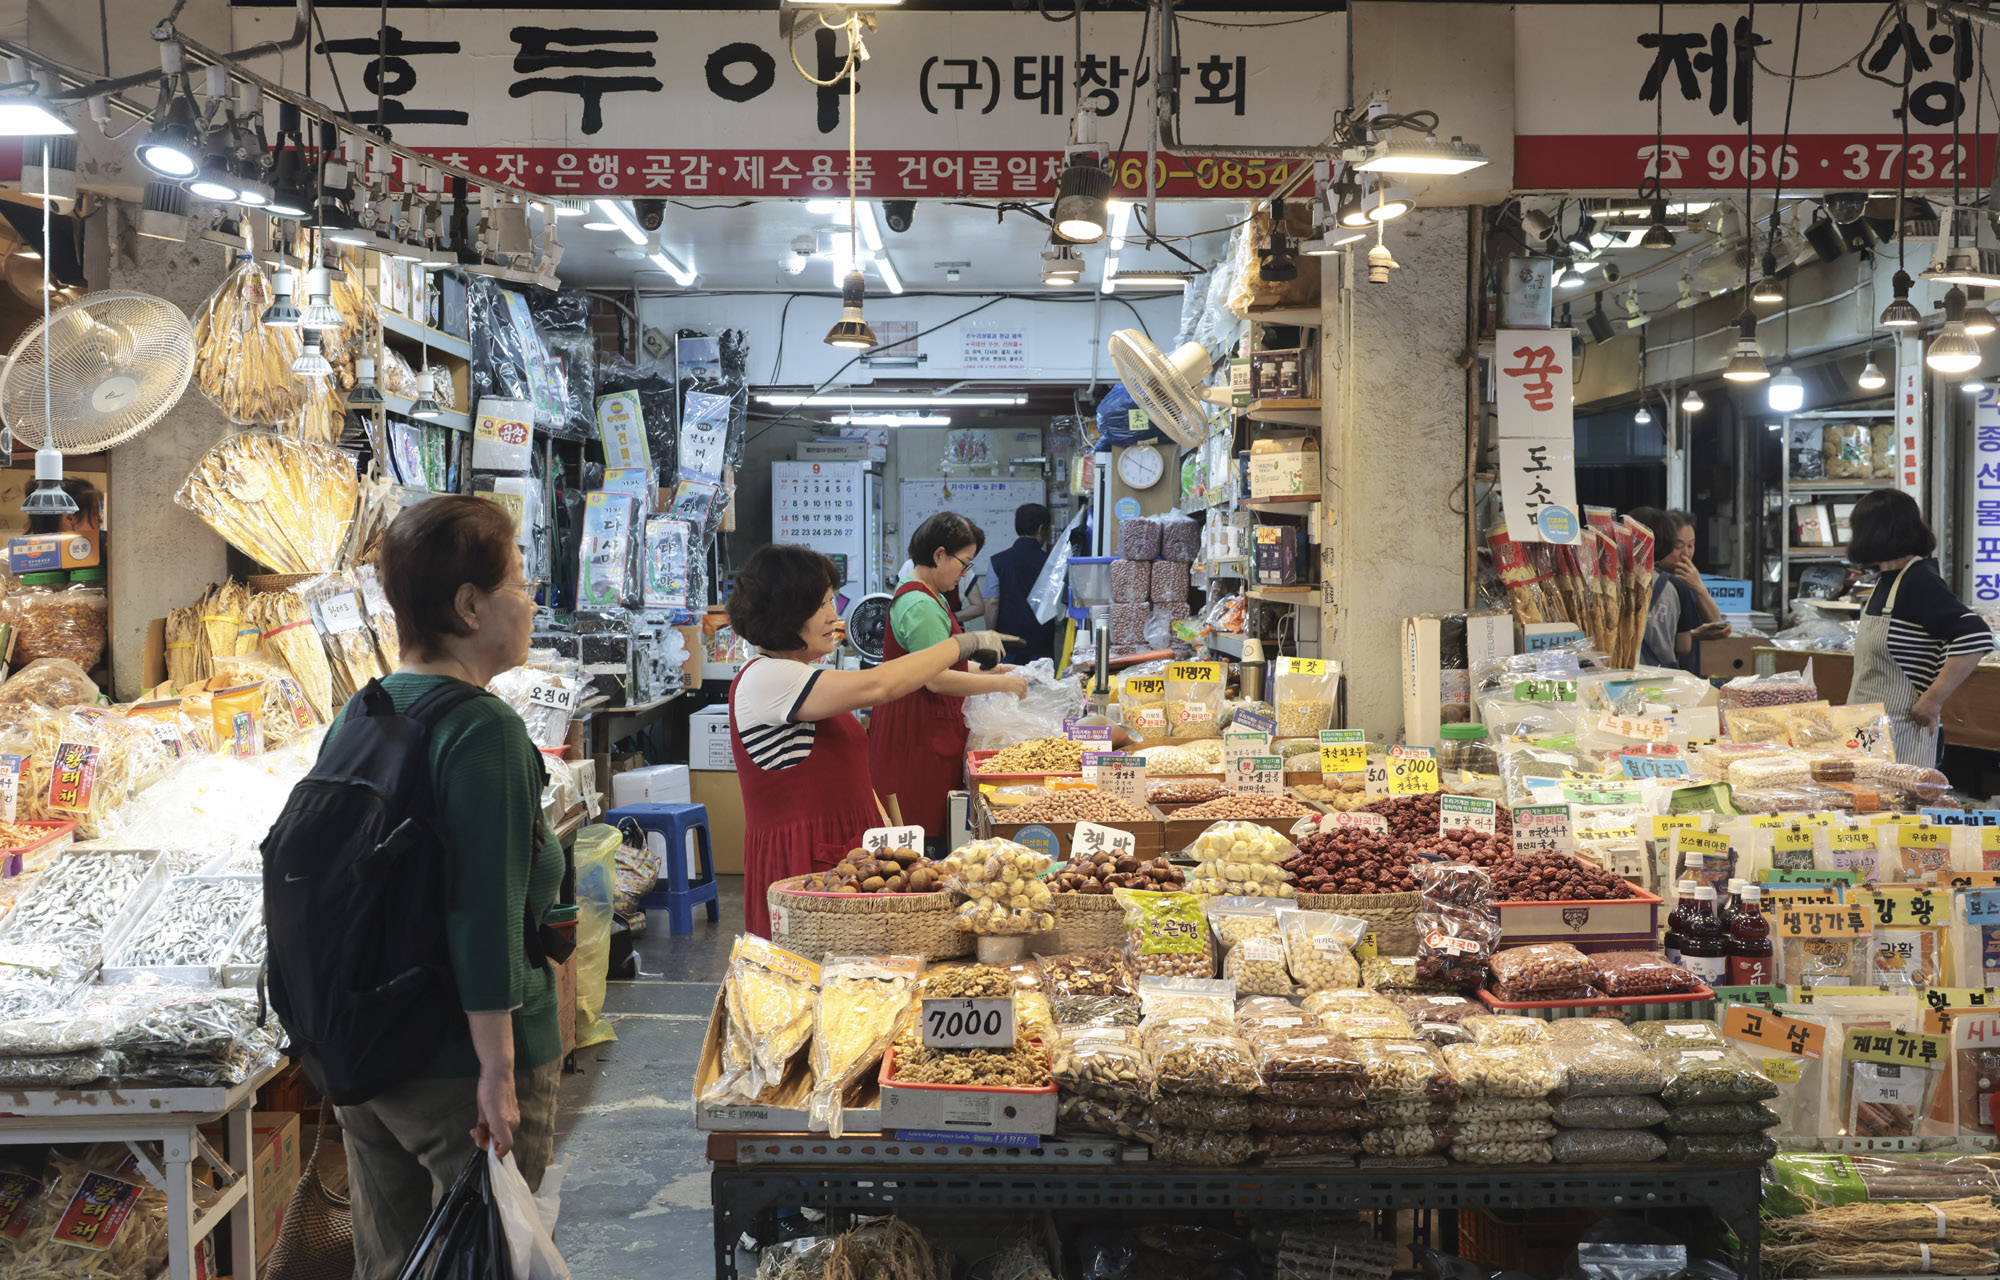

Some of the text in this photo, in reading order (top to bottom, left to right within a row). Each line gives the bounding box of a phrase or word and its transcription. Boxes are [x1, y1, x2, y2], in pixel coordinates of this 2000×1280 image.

[551, 155, 619, 189] 은행
[642, 154, 713, 190] 곶감
[733, 156, 874, 191] 제수용품
[1502, 345, 1564, 412] 꿀
[812, 463, 821, 474] 9
[781, 514, 853, 522] 14 15 16 17 18 19 20
[72, 543, 89, 554] 분홍
[1173, 665, 1212, 681] 가평잣
[530, 686, 571, 707] 오징어
[1191, 712, 1211, 721] 한국산
[1404, 750, 1429, 759] 한국산
[59, 750, 84, 807] 황태채
[1353, 816, 1382, 827] 한국산
[1536, 815, 1565, 826] 한국산
[1022, 838, 1049, 848] 민생회복
[1680, 836, 1727, 851] 보스웰리아환
[1786, 833, 1810, 844] 여주환
[1837, 833, 1869, 843] 도라지환
[1516, 842, 1537, 850] 원산지
[1163, 918, 1199, 940] 은행
[1783, 912, 1865, 935] 생강가루
[1880, 942, 1914, 959] 강황
[1853, 1035, 1938, 1063] 계피가루
[1879, 1088, 1899, 1099] 계피
[995, 1135, 1029, 1145] LABEL
[70, 1184, 118, 1243] 황태채
